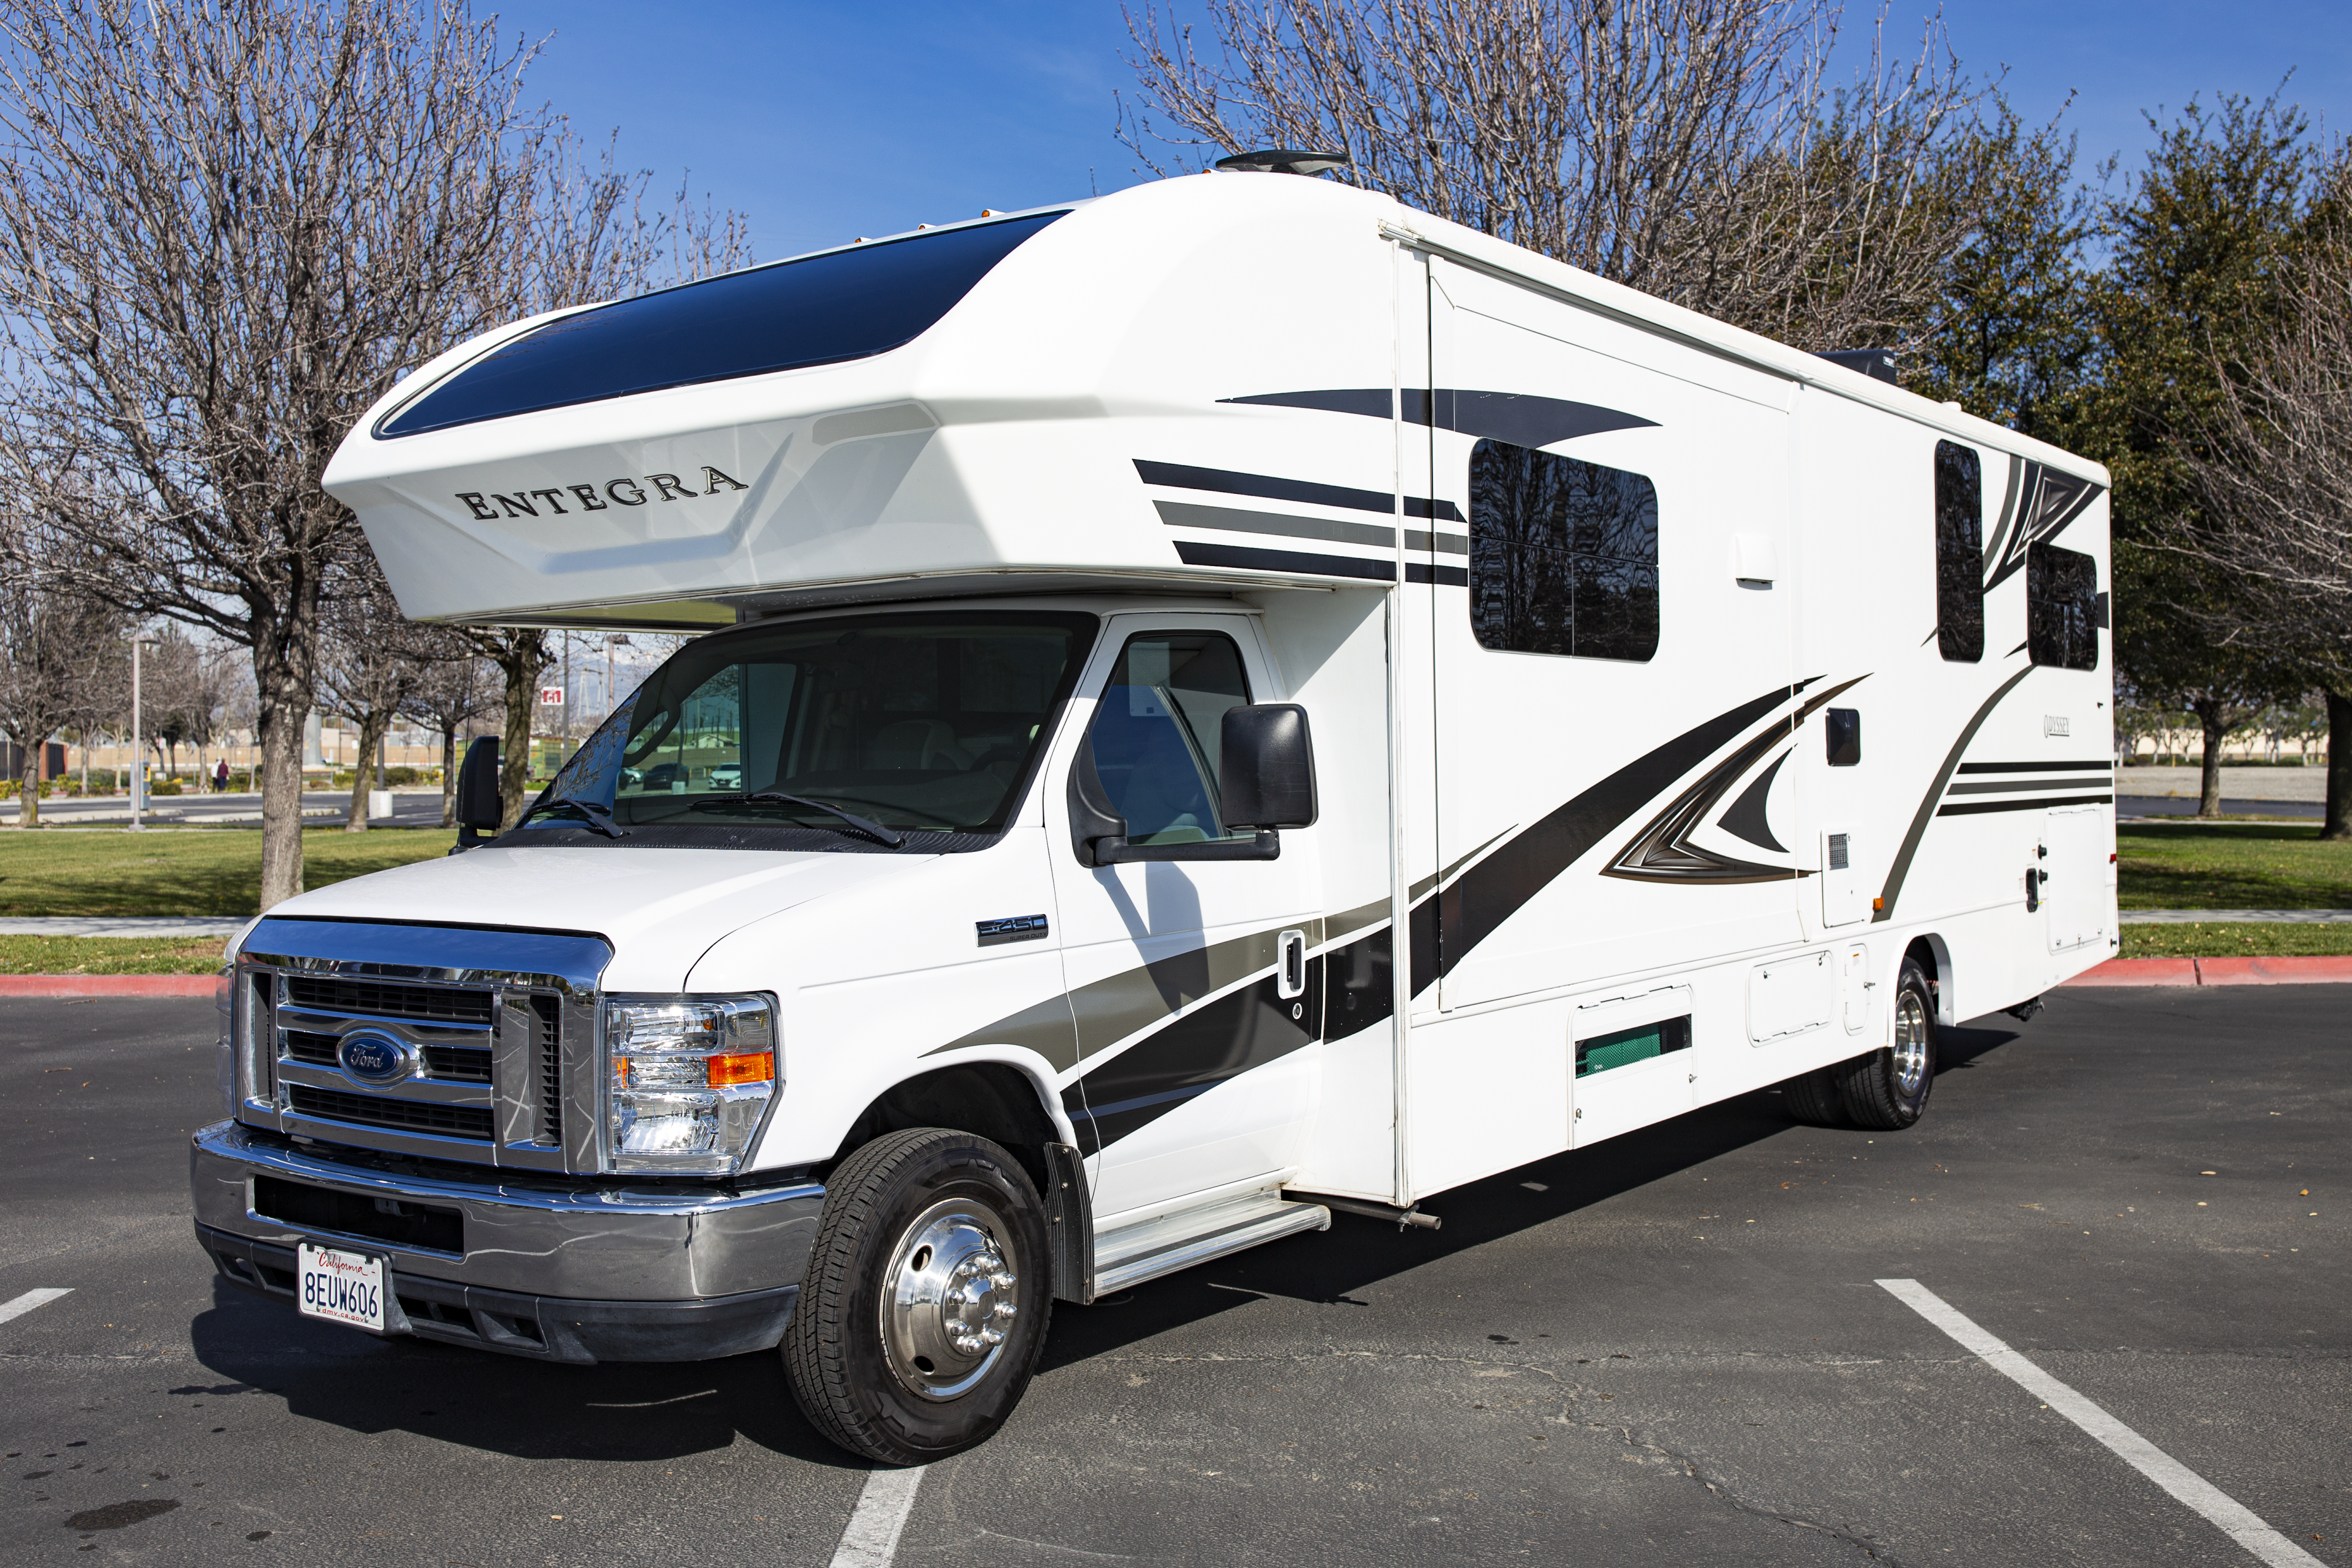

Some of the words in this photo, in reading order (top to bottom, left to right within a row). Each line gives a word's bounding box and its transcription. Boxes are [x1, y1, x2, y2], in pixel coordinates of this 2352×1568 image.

[455, 466, 749, 520] ENTEGRA
[978, 917, 1047, 937] E-450
[350, 1044, 384, 1069] Ford
[318, 1252, 369, 1276] California
[305, 1272, 377, 1318] 8EUW606
[322, 1308, 365, 1322] dmv.ca.gov
